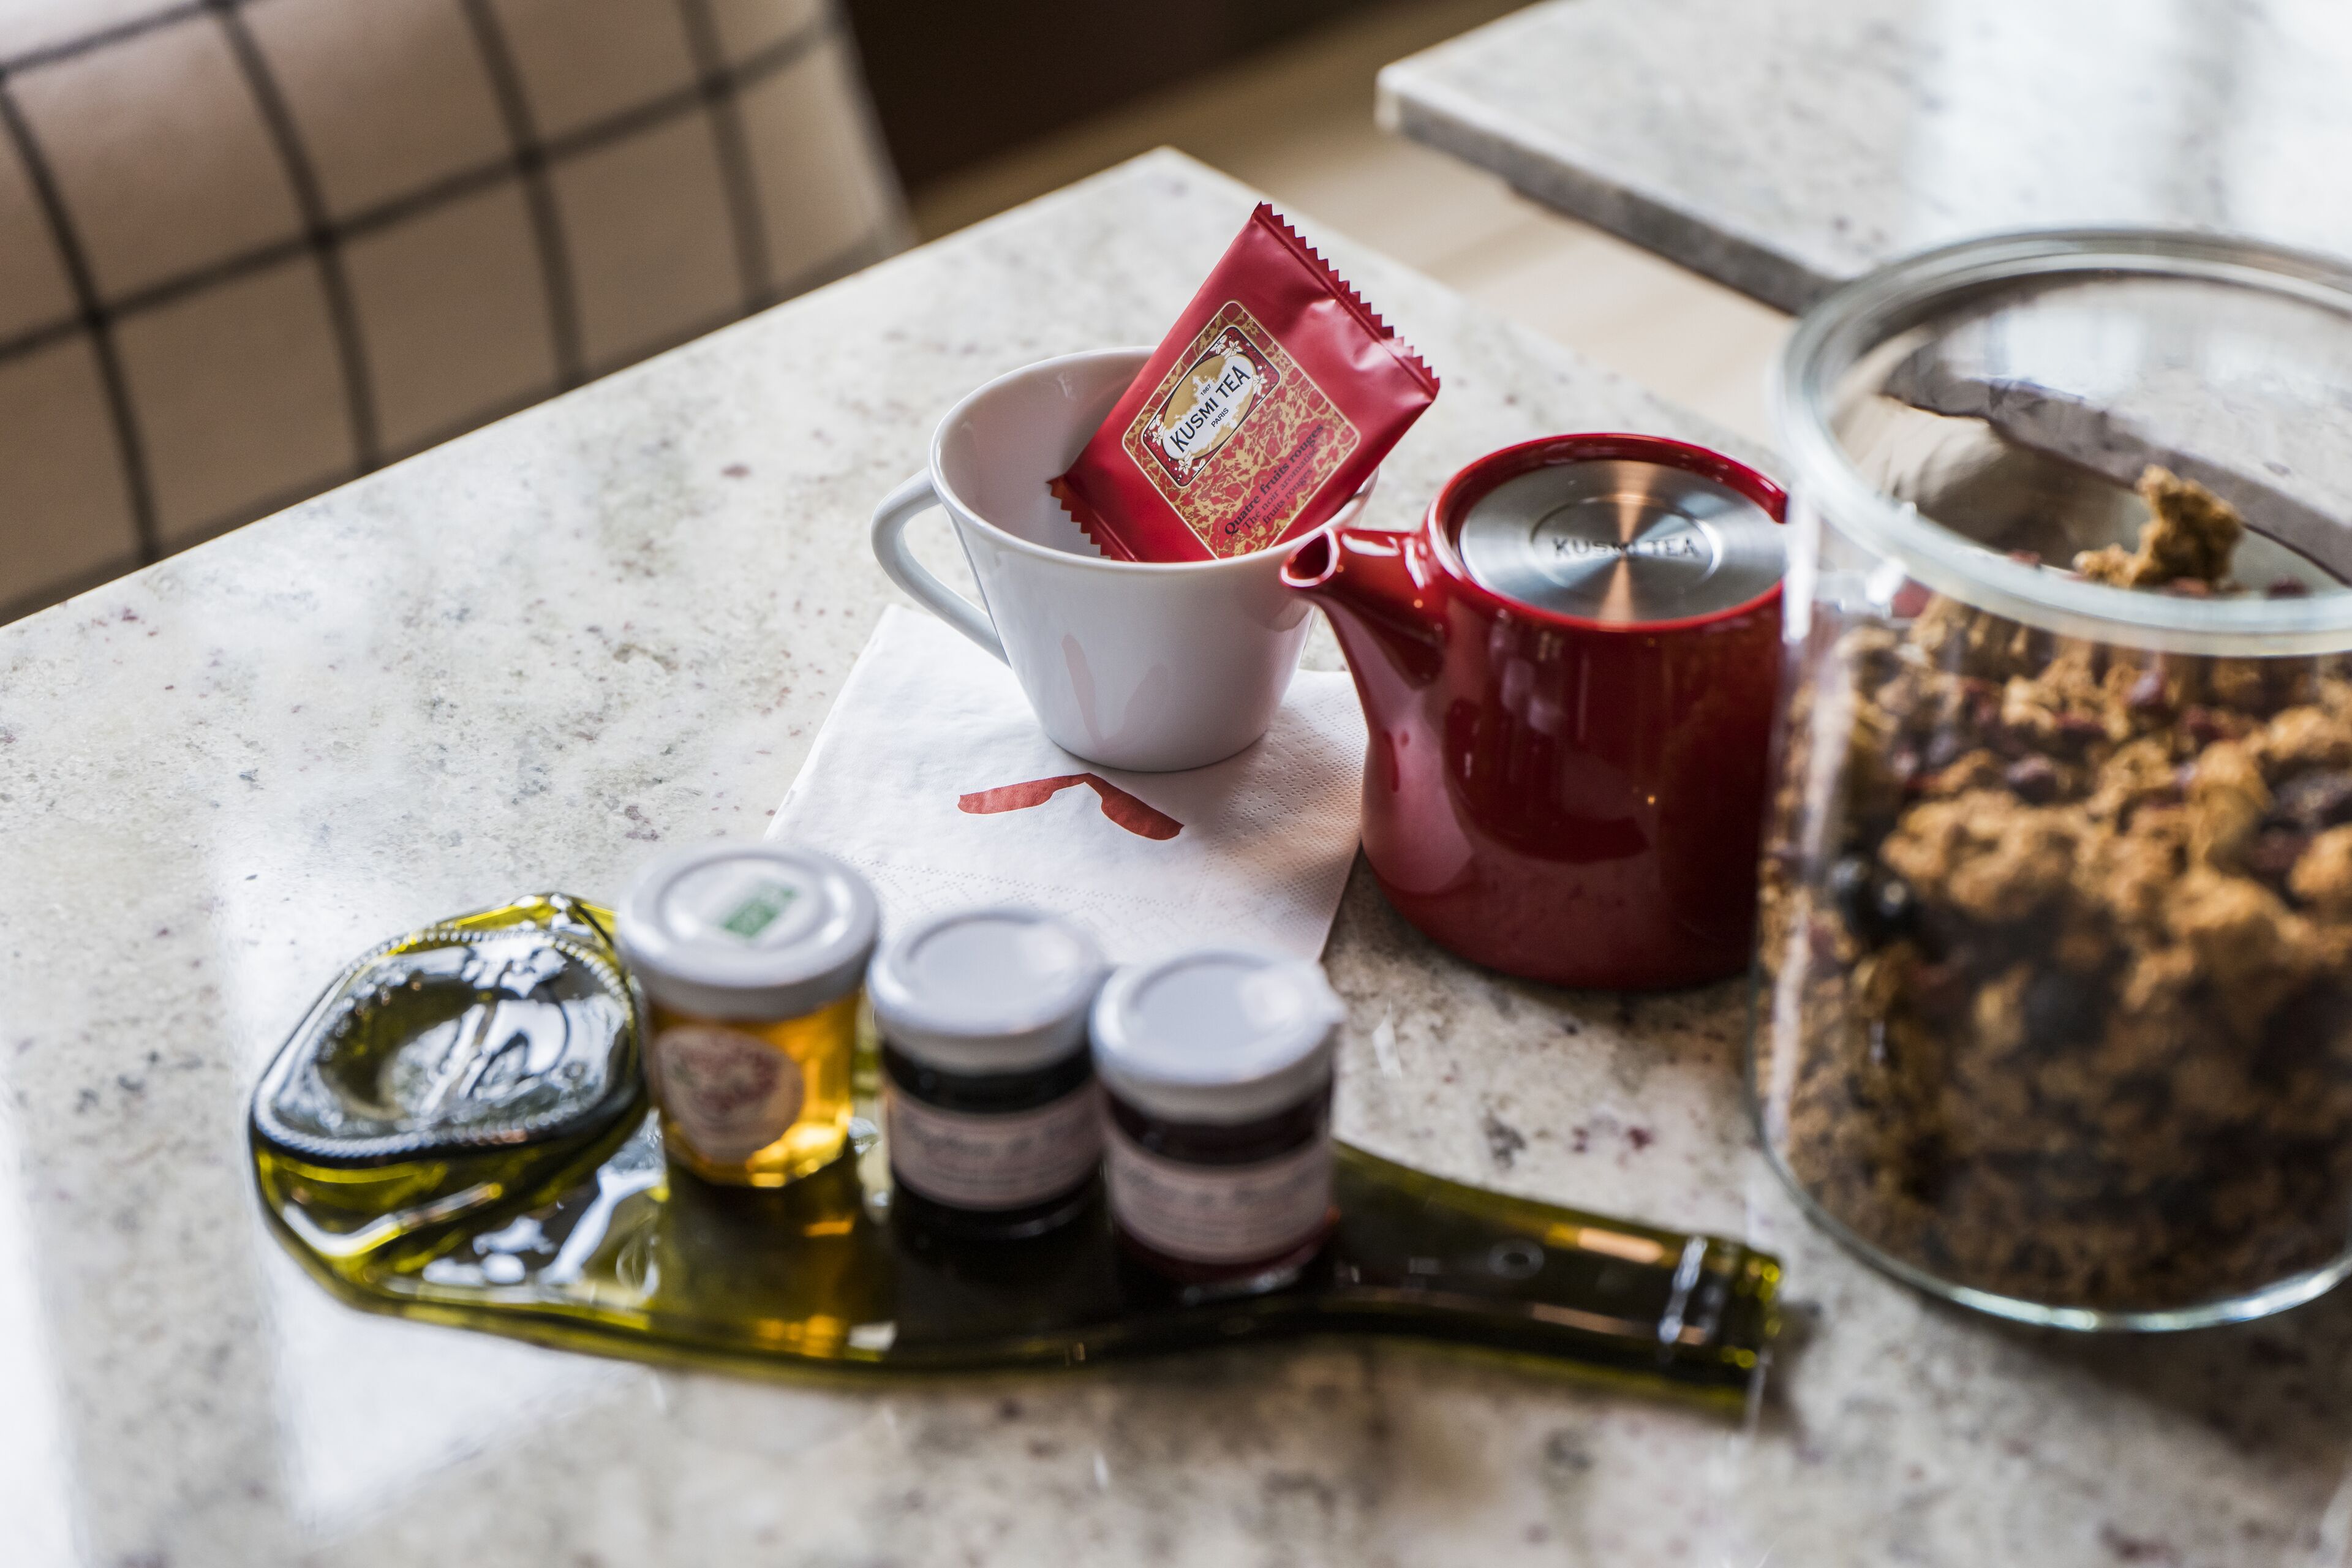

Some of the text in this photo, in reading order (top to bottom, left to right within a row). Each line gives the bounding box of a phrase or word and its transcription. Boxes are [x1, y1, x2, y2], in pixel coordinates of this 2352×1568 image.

[1200, 383, 1211, 396] 1867
[1169, 366, 1251, 453] KUSMI TEA
[1211, 407, 1229, 428] PARIS
[1224, 424, 1324, 537] Quatre fruits rouges
[1262, 469, 1313, 525] fruits rouges
[1242, 509, 1262, 530] Thé
[1262, 492, 1279, 511] noir
[1646, 535, 1700, 558] TEA
